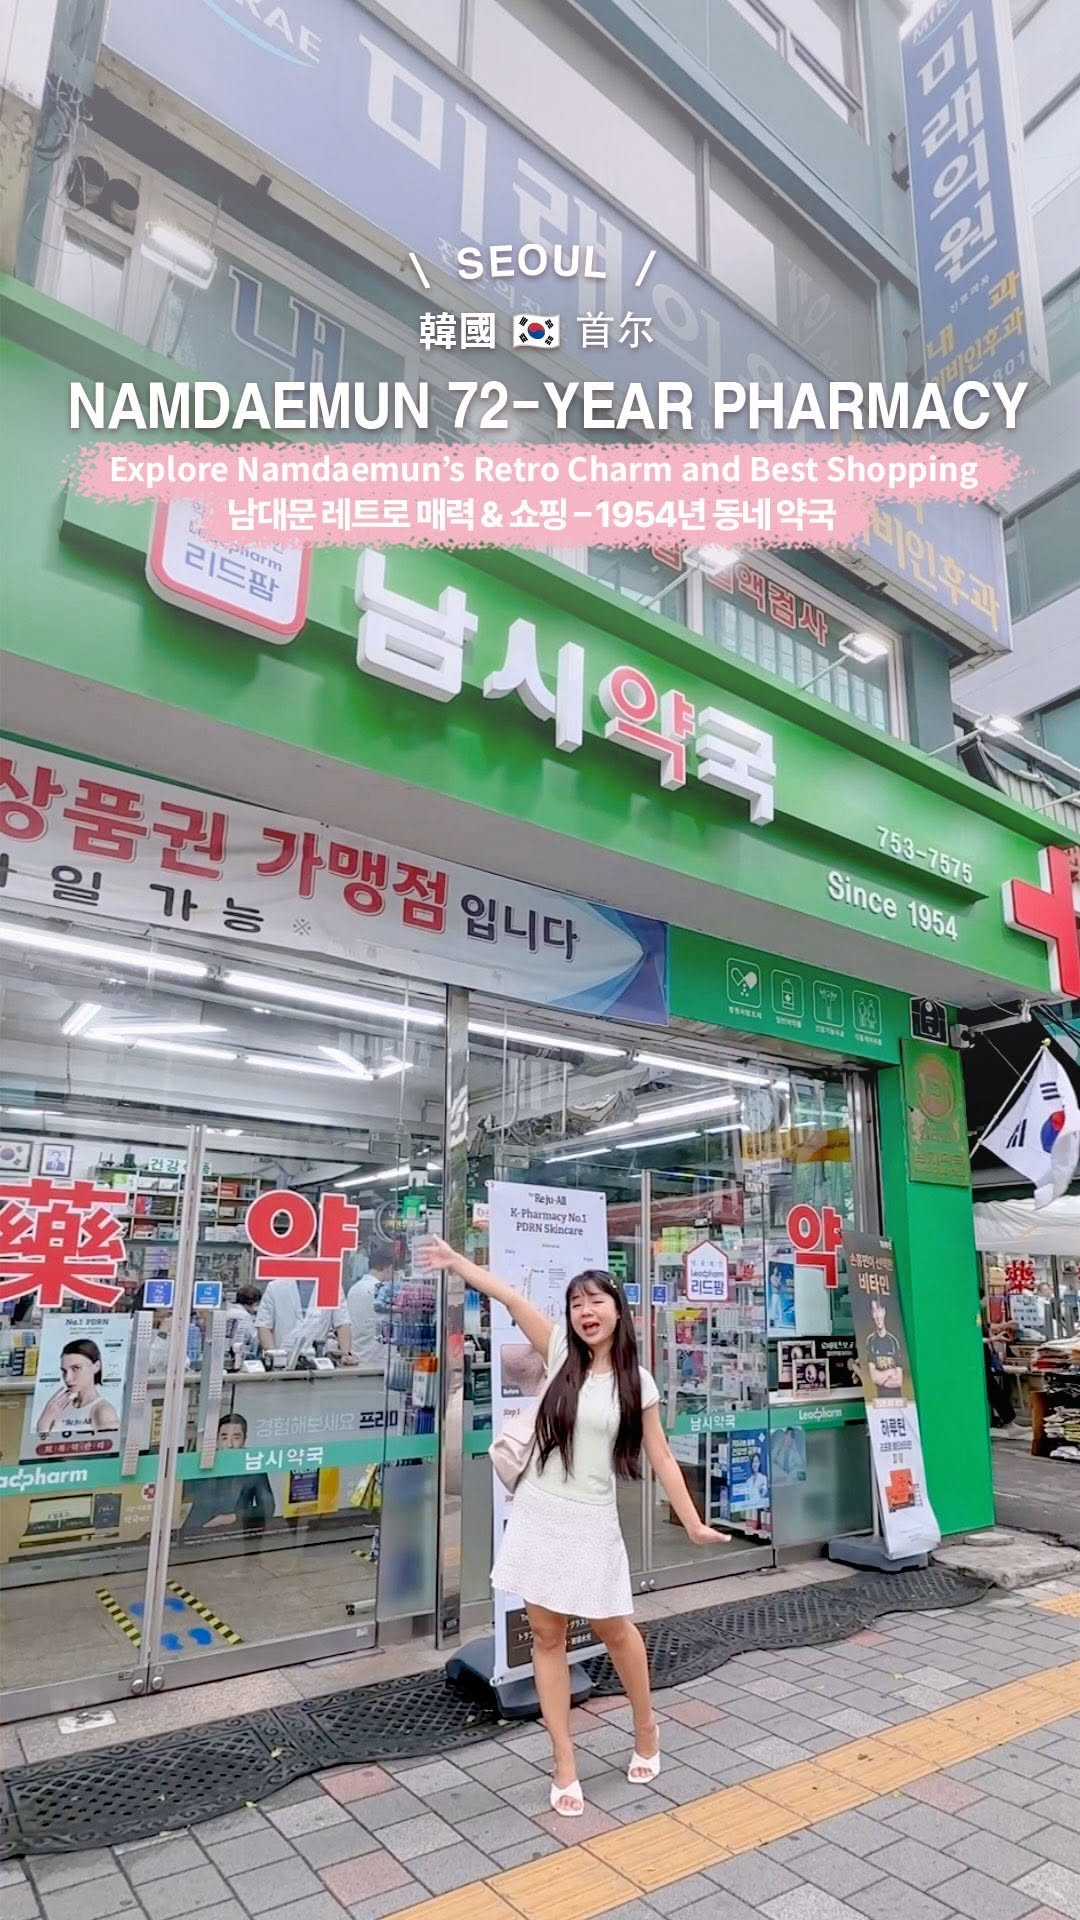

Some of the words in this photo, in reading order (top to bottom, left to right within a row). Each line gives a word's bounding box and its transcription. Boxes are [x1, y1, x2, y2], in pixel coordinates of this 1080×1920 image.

[917, 10, 998, 284] 미래의원
[184, 541, 280, 603] 리드팜
[354, 547, 776, 827] 남시약국
[877, 825, 974, 886] 753-7575
[256, 826, 450, 936] 가맹점
[461, 893, 580, 963] 입니다
[827, 871, 898, 920] Since
[907, 899, 959, 941] 1954
[0, 1177, 129, 1308] 藥
[510, 1207, 568, 1224] K-Pharmacy
[568, 1213, 588, 1224] No.1
[516, 1221, 543, 1233] PDRN
[543, 1222, 584, 1236] Skincare
[787, 1203, 843, 1288] 약
[245, 1189, 360, 1309] 약
[691, 1279, 725, 1296] 리드팜
[858, 1271, 891, 1296] 비타민
[255, 1411, 355, 1439] 경험해보세요
[690, 1413, 736, 1432] 남시약국
[799, 1408, 843, 1422] Leadpharm
[245, 1446, 324, 1471] 남시약국
